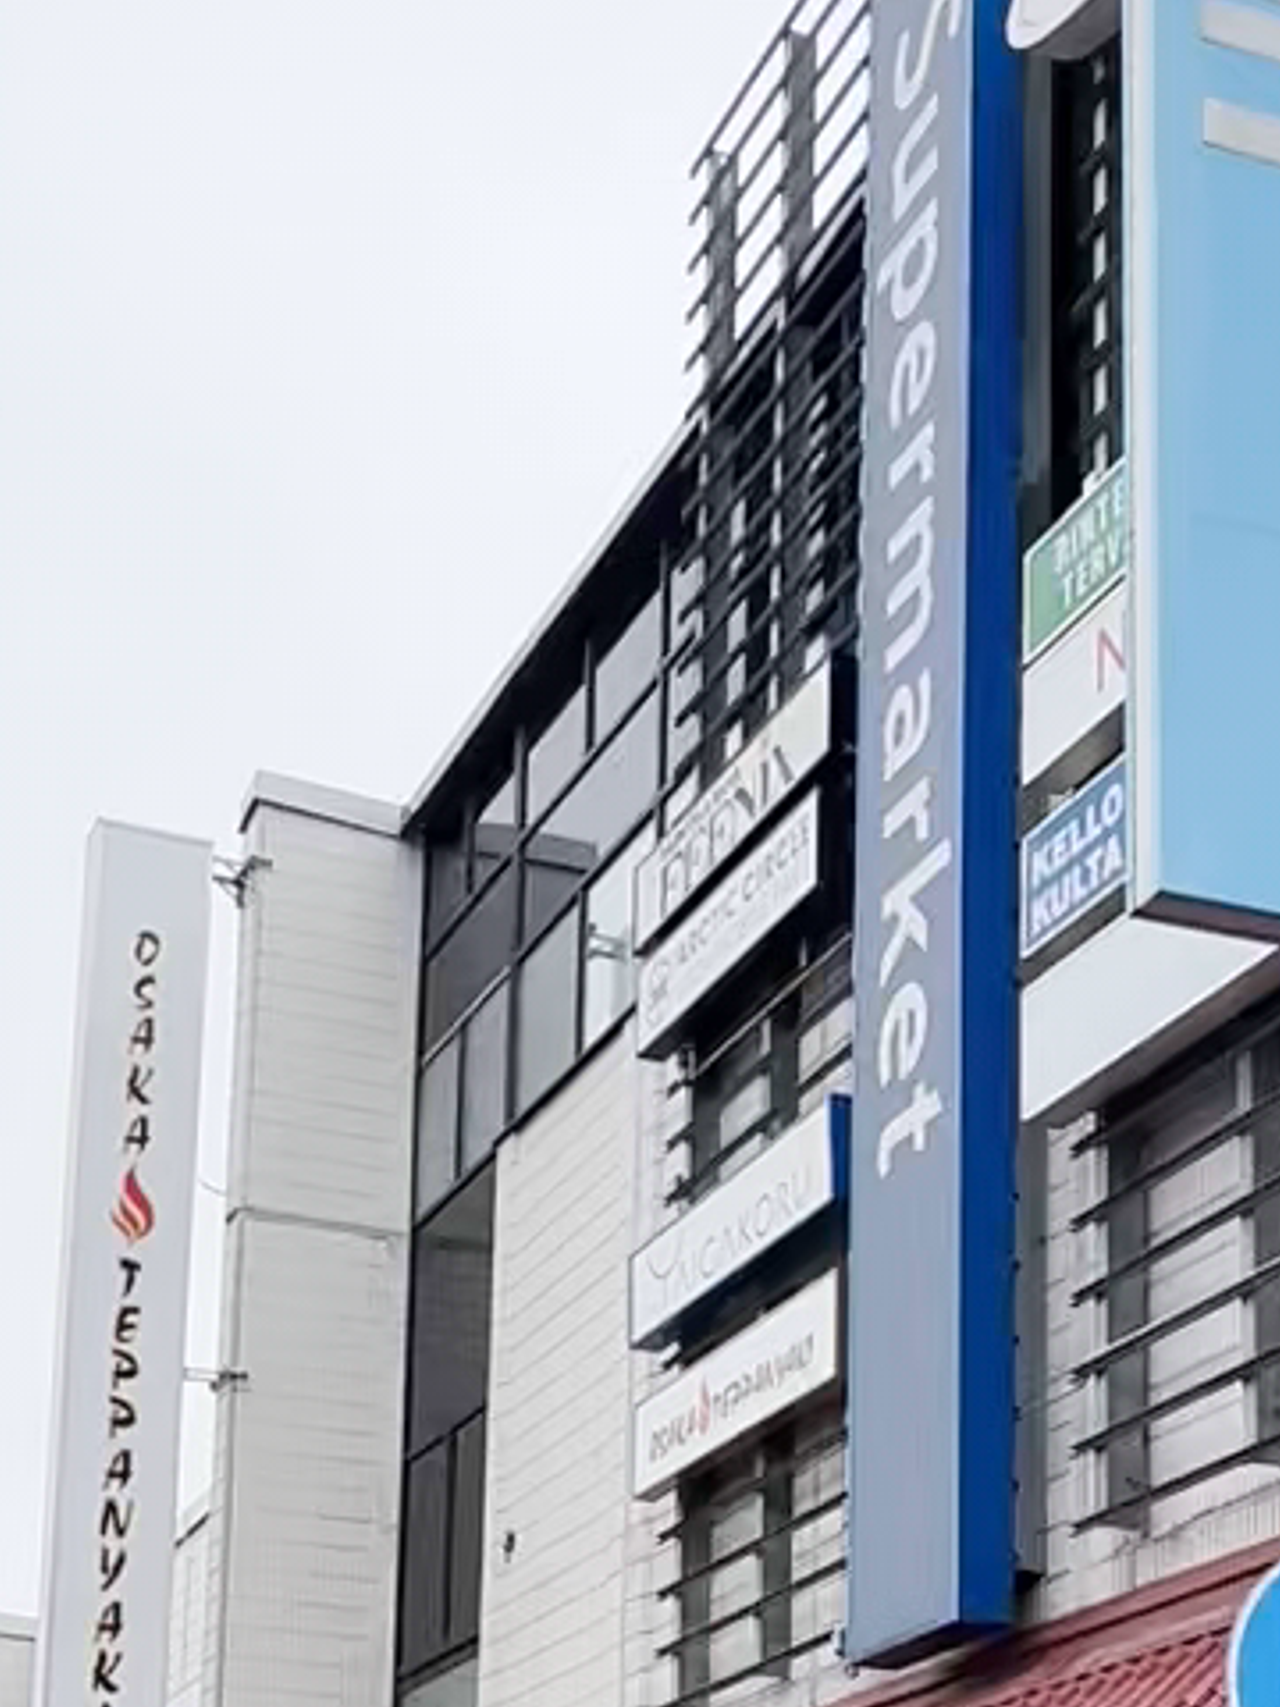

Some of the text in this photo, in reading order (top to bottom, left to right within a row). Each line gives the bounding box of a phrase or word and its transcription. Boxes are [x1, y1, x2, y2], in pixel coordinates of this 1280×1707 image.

[1030, 833, 1123, 937] KULTA
[1031, 780, 1122, 887] KELLO
[123, 929, 161, 1155] OSAKA
